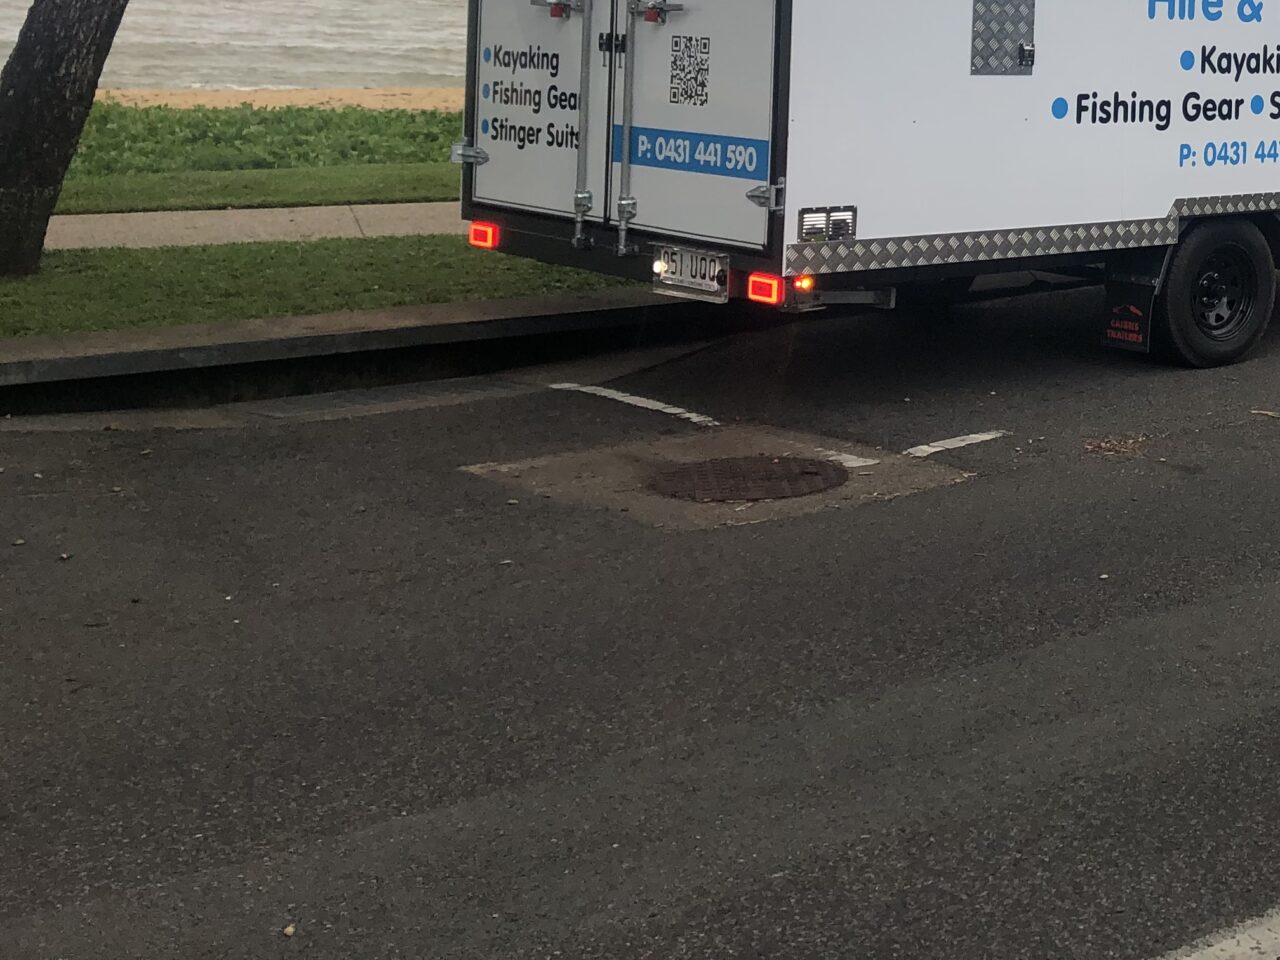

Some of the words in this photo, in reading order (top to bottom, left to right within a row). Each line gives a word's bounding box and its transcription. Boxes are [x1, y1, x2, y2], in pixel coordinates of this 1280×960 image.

[493, 45, 560, 78] Kayaking
[492, 80, 542, 114] Fishing
[547, 84, 581, 111] Gea
[1076, 91, 1171, 131] Fishing
[1182, 91, 1244, 122] Gear
[491, 117, 542, 150] Stinger
[637, 134, 651, 159] P:
[655, 136, 690, 164] 0431
[694, 141, 722, 168] 441
[725, 144, 757, 172] 590
[1179, 143, 1197, 167] P:
[1203, 141, 1247, 167] 0431
